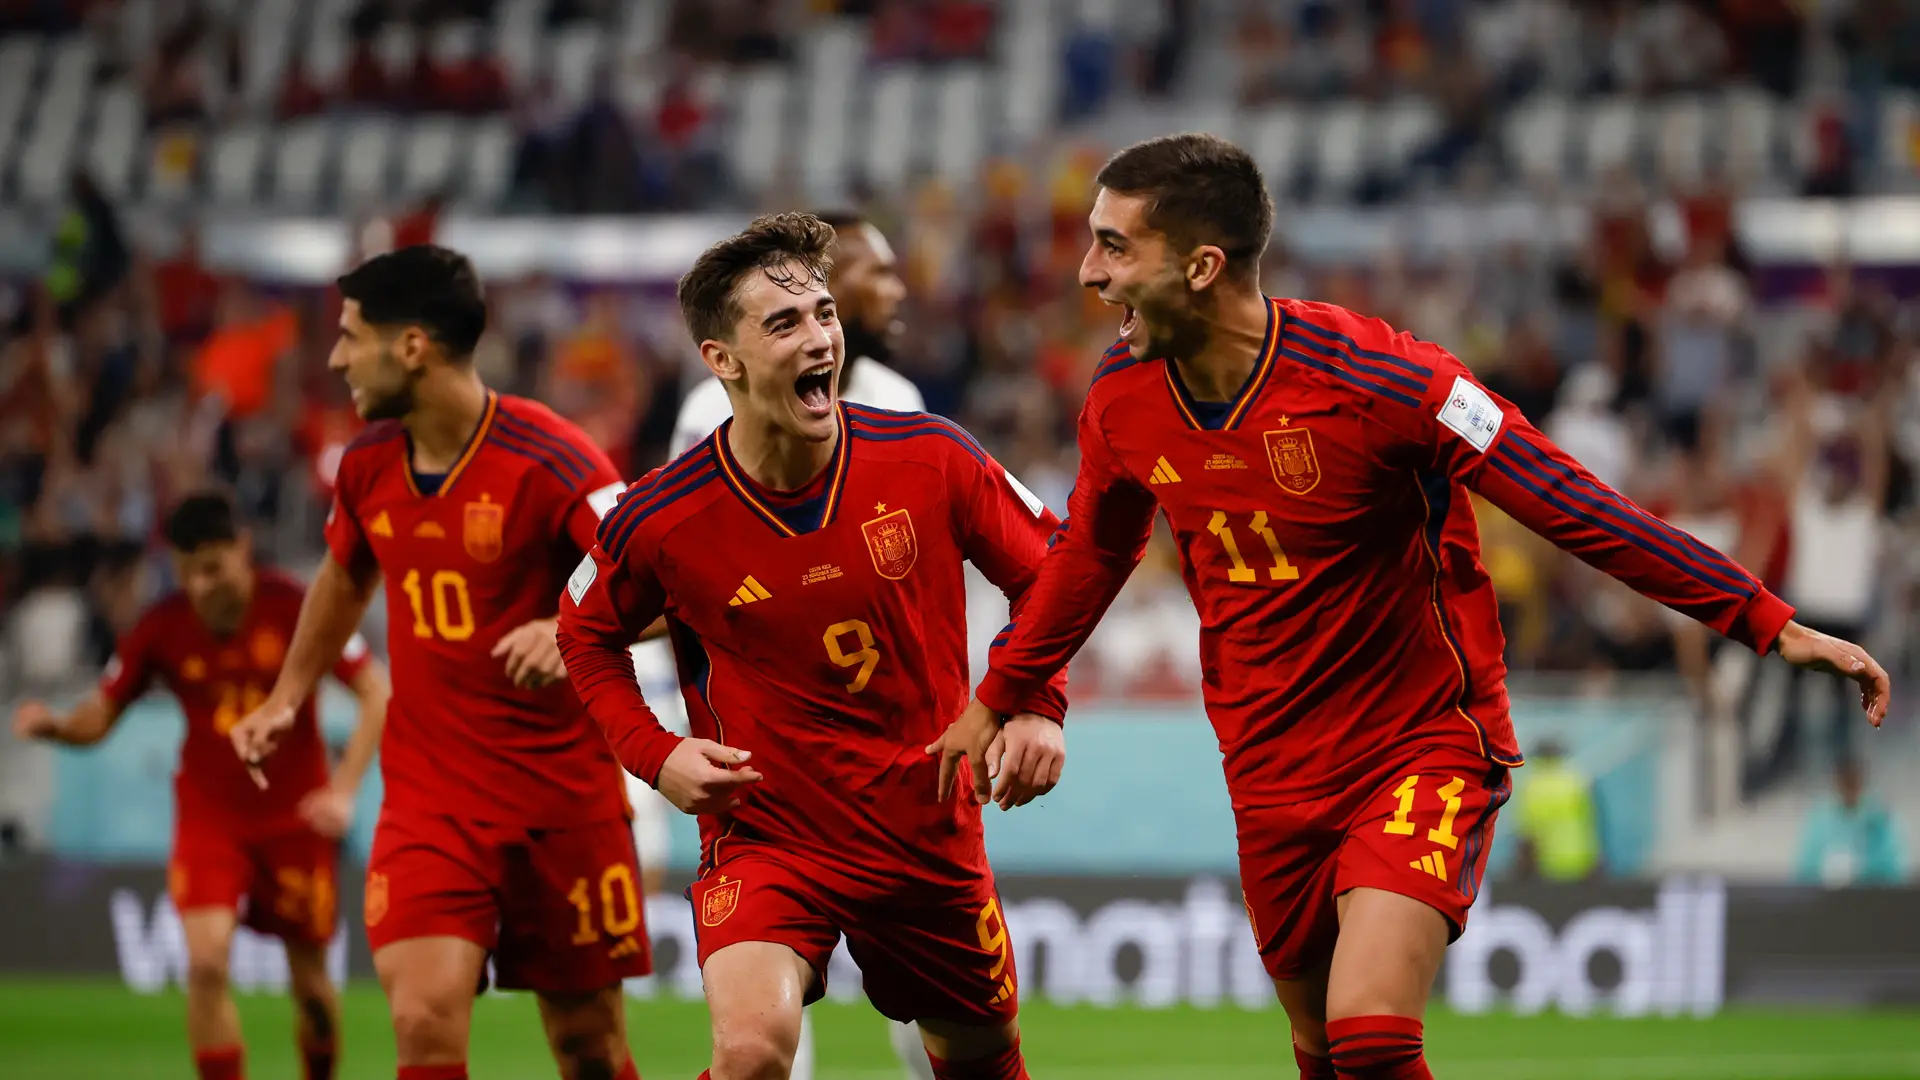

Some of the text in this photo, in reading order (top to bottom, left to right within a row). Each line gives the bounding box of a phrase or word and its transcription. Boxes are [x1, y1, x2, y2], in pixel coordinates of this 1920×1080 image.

[1206, 511, 1299, 582] 11
[402, 569, 476, 641] 10
[822, 619, 880, 694] 9
[1383, 775, 1465, 850] 11
[566, 863, 639, 945] 10
[976, 896, 1007, 980] 9
[1446, 873, 1726, 1018] ball
